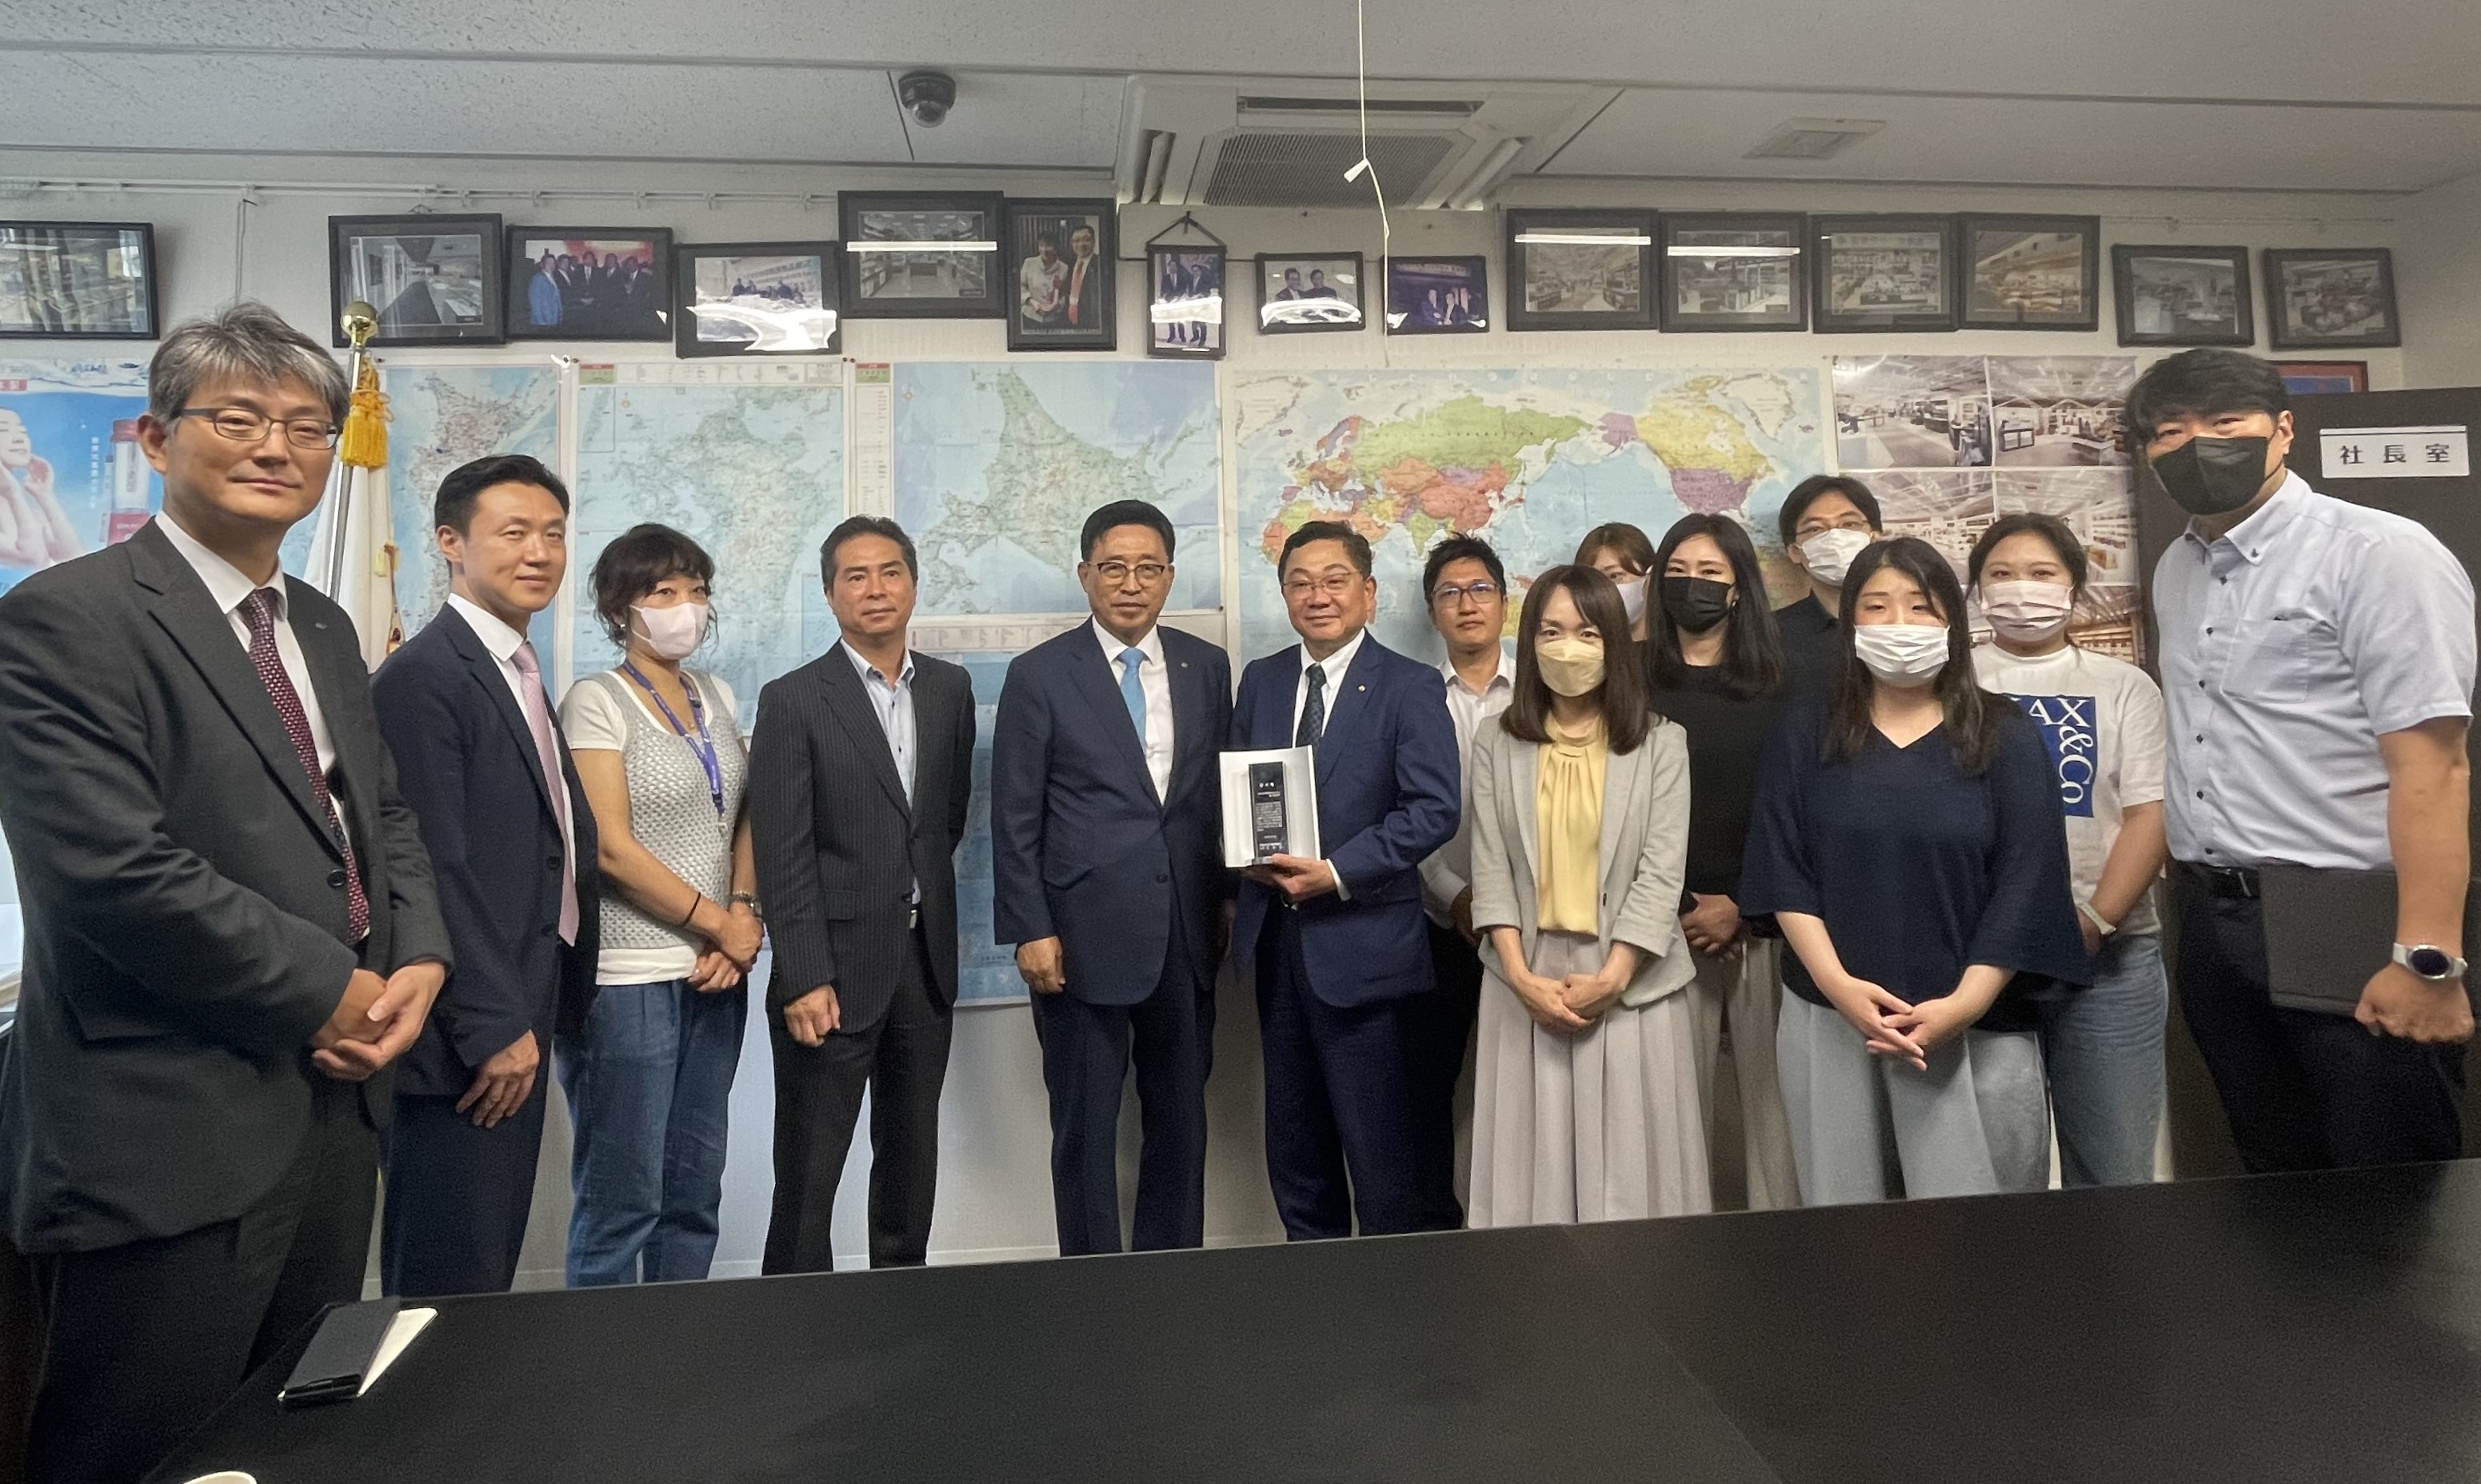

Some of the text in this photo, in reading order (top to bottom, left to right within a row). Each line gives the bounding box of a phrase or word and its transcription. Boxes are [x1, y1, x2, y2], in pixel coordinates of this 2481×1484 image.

[2339, 443, 2450, 465] 社長室
[2010, 696, 2091, 728] AX
